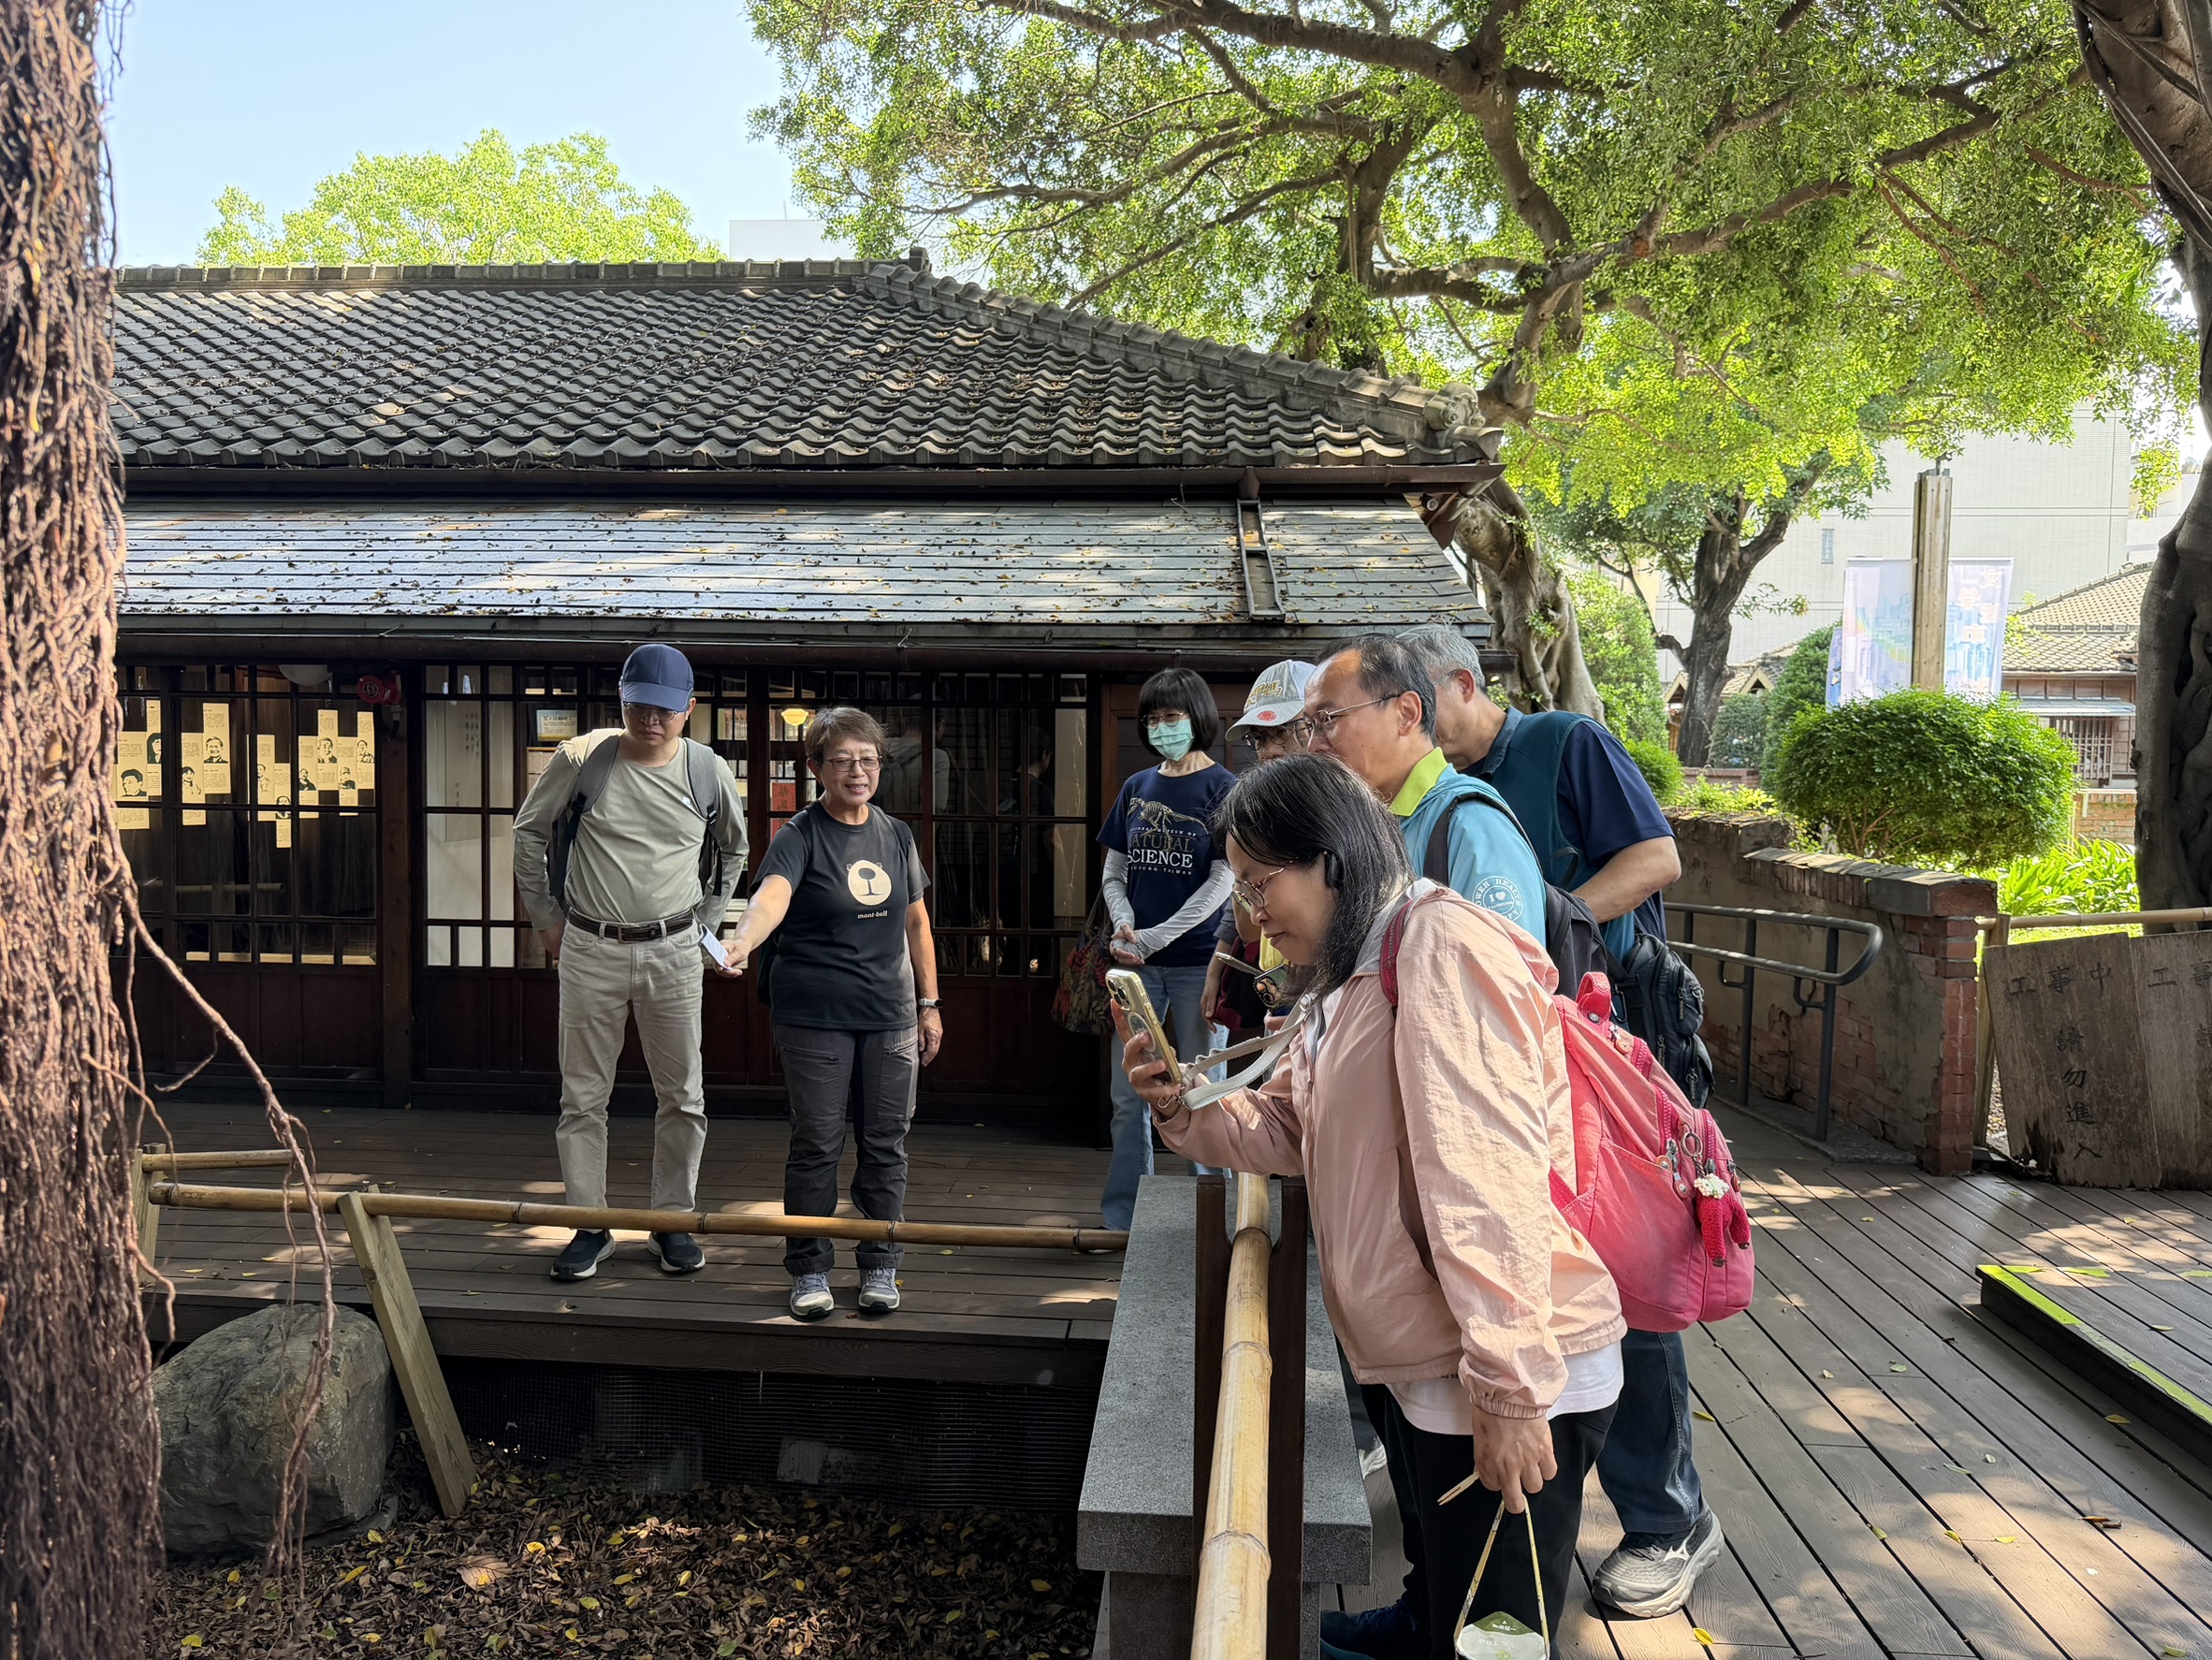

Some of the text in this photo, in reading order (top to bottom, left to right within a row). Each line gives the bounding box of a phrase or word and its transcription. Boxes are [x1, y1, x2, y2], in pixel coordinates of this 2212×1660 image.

[1128, 849, 1193, 867] SCIENCE
[1489, 894, 1495, 903] I
[857, 910, 888, 920] mont-bell
[2006, 961, 2112, 996] 工事中
[2057, 1027, 2103, 1160] 請勿進入
